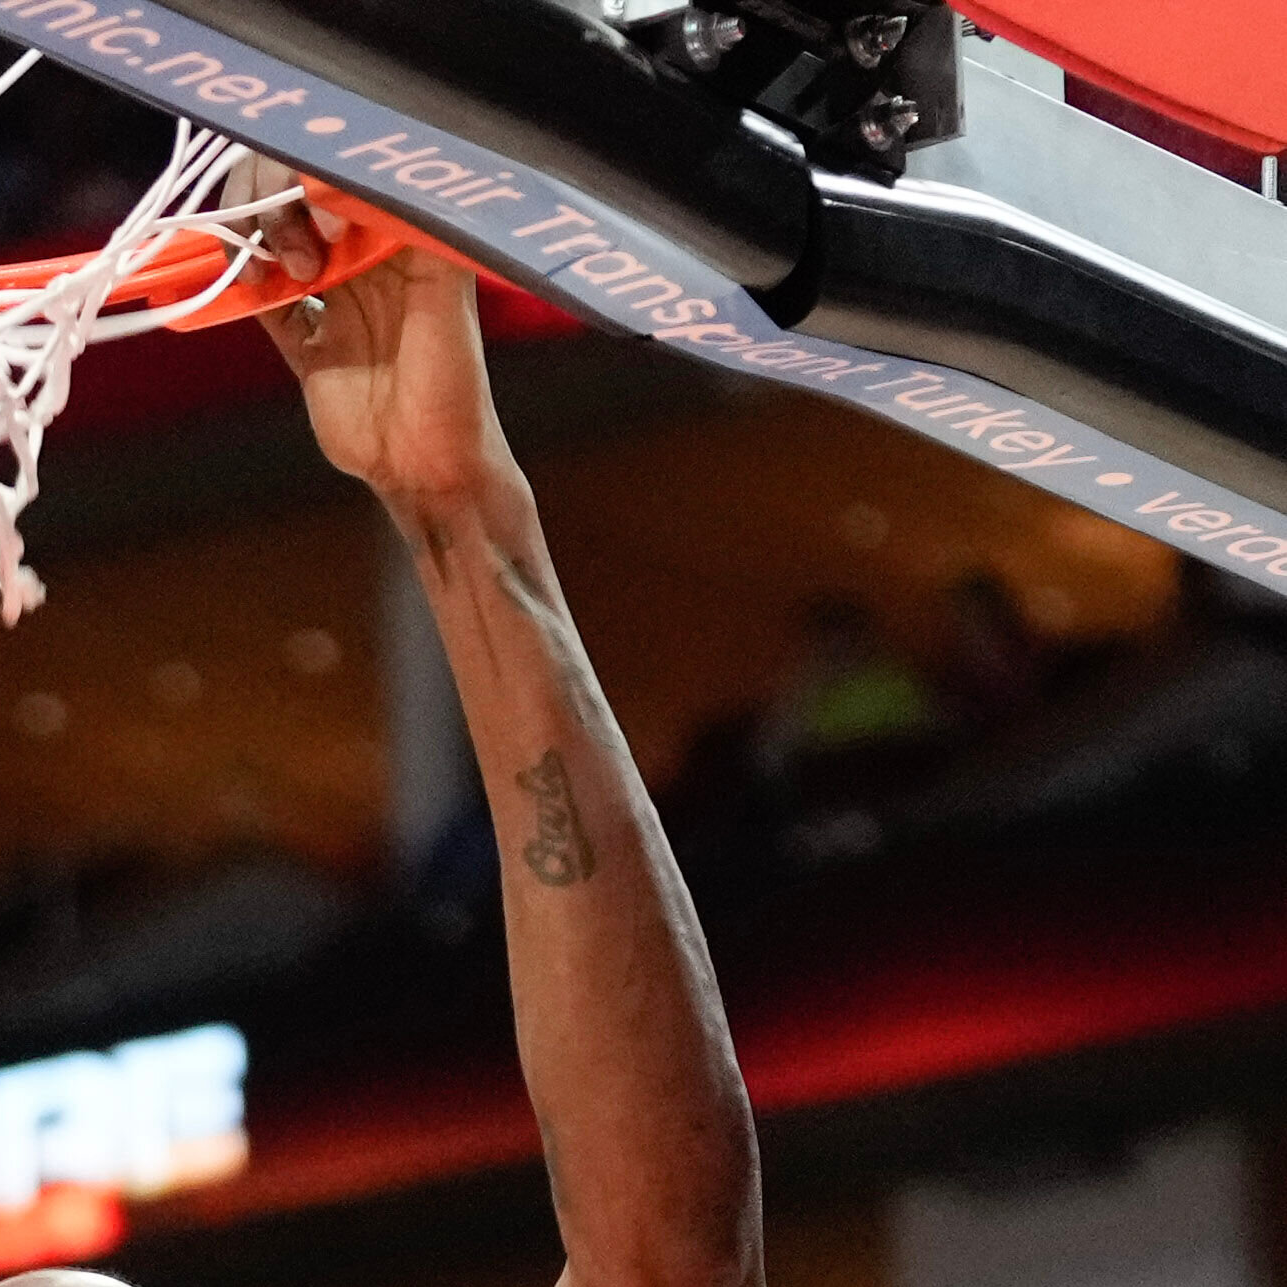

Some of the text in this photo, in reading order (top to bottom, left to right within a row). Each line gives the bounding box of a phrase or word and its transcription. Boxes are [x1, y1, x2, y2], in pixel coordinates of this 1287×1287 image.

[337, 132, 524, 207] Hair
[512, 204, 887, 382] Transplant
[864, 370, 1098, 470] Turkey
